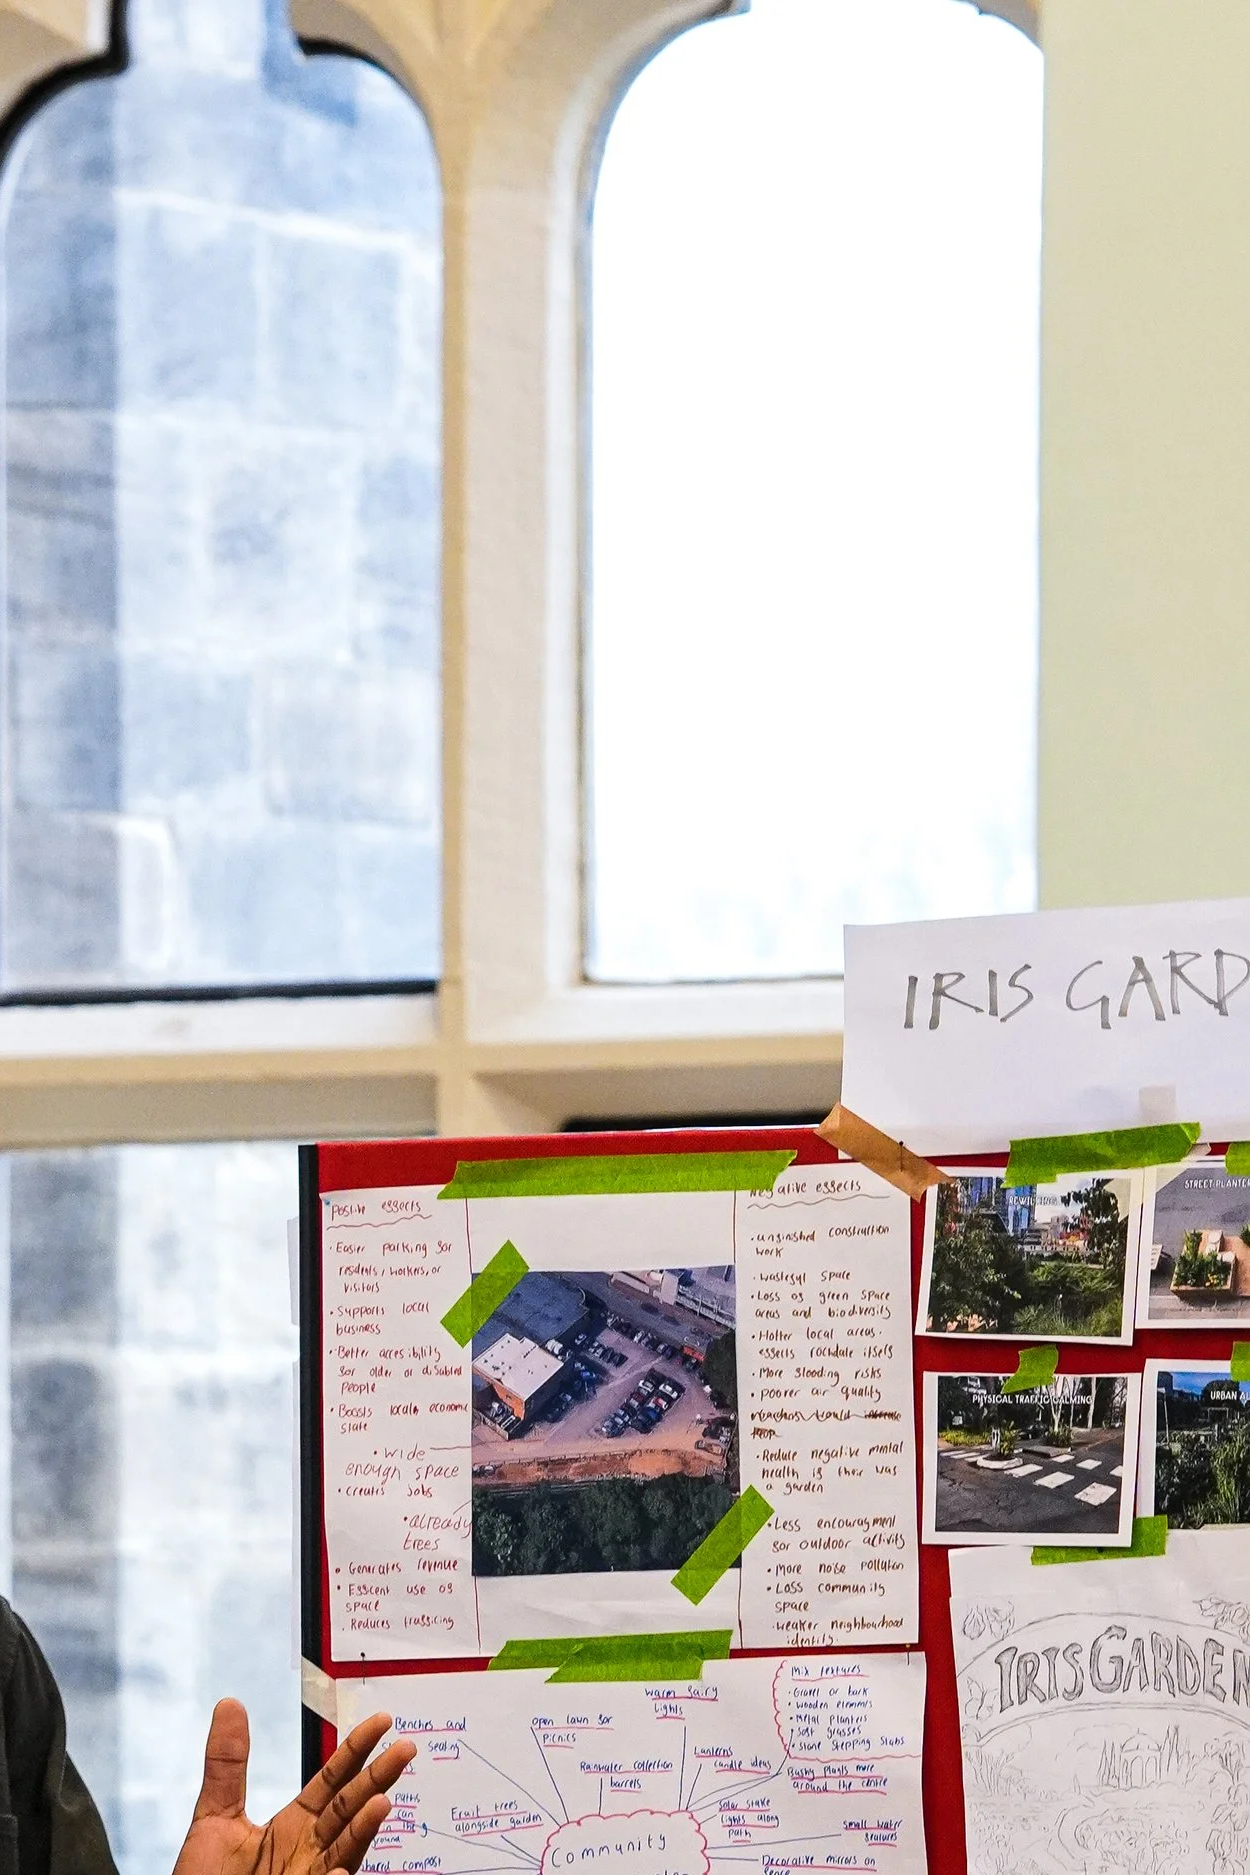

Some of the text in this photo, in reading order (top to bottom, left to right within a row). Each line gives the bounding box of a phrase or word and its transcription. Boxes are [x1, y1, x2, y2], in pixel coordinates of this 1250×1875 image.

[904, 949, 1250, 1030] IRIS GARD
[1185, 1179, 1212, 1188] STREET
[829, 1225, 889, 1237] construction
[336, 1242, 427, 1258] Easier parking
[756, 1248, 783, 1258] work
[432, 1266, 441, 1274] or
[757, 1291, 780, 1302] Loss
[819, 1291, 849, 1304] green
[338, 1302, 429, 1318] Supports local
[755, 1305, 891, 1319] areas and biodiversity
[336, 1324, 381, 1335] business
[759, 1327, 834, 1341] Hotter local
[337, 1346, 369, 1357] Better
[370, 1365, 392, 1377] older
[404, 1369, 413, 1377] or
[759, 1368, 881, 1379] More risks
[811, 1388, 826, 1396] air
[841, 1386, 881, 1402] quality
[972, 1395, 1092, 1404] PHYSICAL TRAFFIC CALMING
[1211, 1391, 1237, 1400] URBAN
[339, 1404, 372, 1417] Boosts
[762, 1442, 904, 1463] Reduce negative mental
[345, 1463, 459, 1484] enough space
[762, 1466, 799, 1479] health
[875, 1466, 897, 1476] was
[766, 1483, 823, 1495] a garden
[409, 1514, 472, 1537] already
[774, 1518, 800, 1531] Less
[403, 1532, 440, 1551] trees
[800, 1534, 905, 1550] outdoor activity
[349, 1559, 458, 1575] Generates revenue
[818, 1563, 846, 1574] noise
[406, 1585, 426, 1595] use
[818, 1583, 885, 1596] community
[346, 1601, 380, 1612] space
[775, 1601, 809, 1612] space
[351, 1618, 390, 1629] Reduces
[831, 1617, 903, 1630] neighbourhood
[792, 1666, 809, 1676] Mix
[848, 1687, 869, 1696] bark
[395, 1717, 466, 1730] Benches and
[796, 1715, 819, 1725] Metal
[827, 1727, 861, 1738] grasses
[694, 1747, 733, 1756] Lanterns
[581, 1761, 622, 1774] Rainwater
[610, 1777, 642, 1789] barrels
[792, 1781, 828, 1792] around
[838, 1779, 852, 1790] the
[451, 1801, 518, 1820] Fruit trees
[455, 1814, 541, 1833] alongside garden
[762, 1855, 814, 1866] Decorative
[826, 1856, 857, 1865] mirrors
